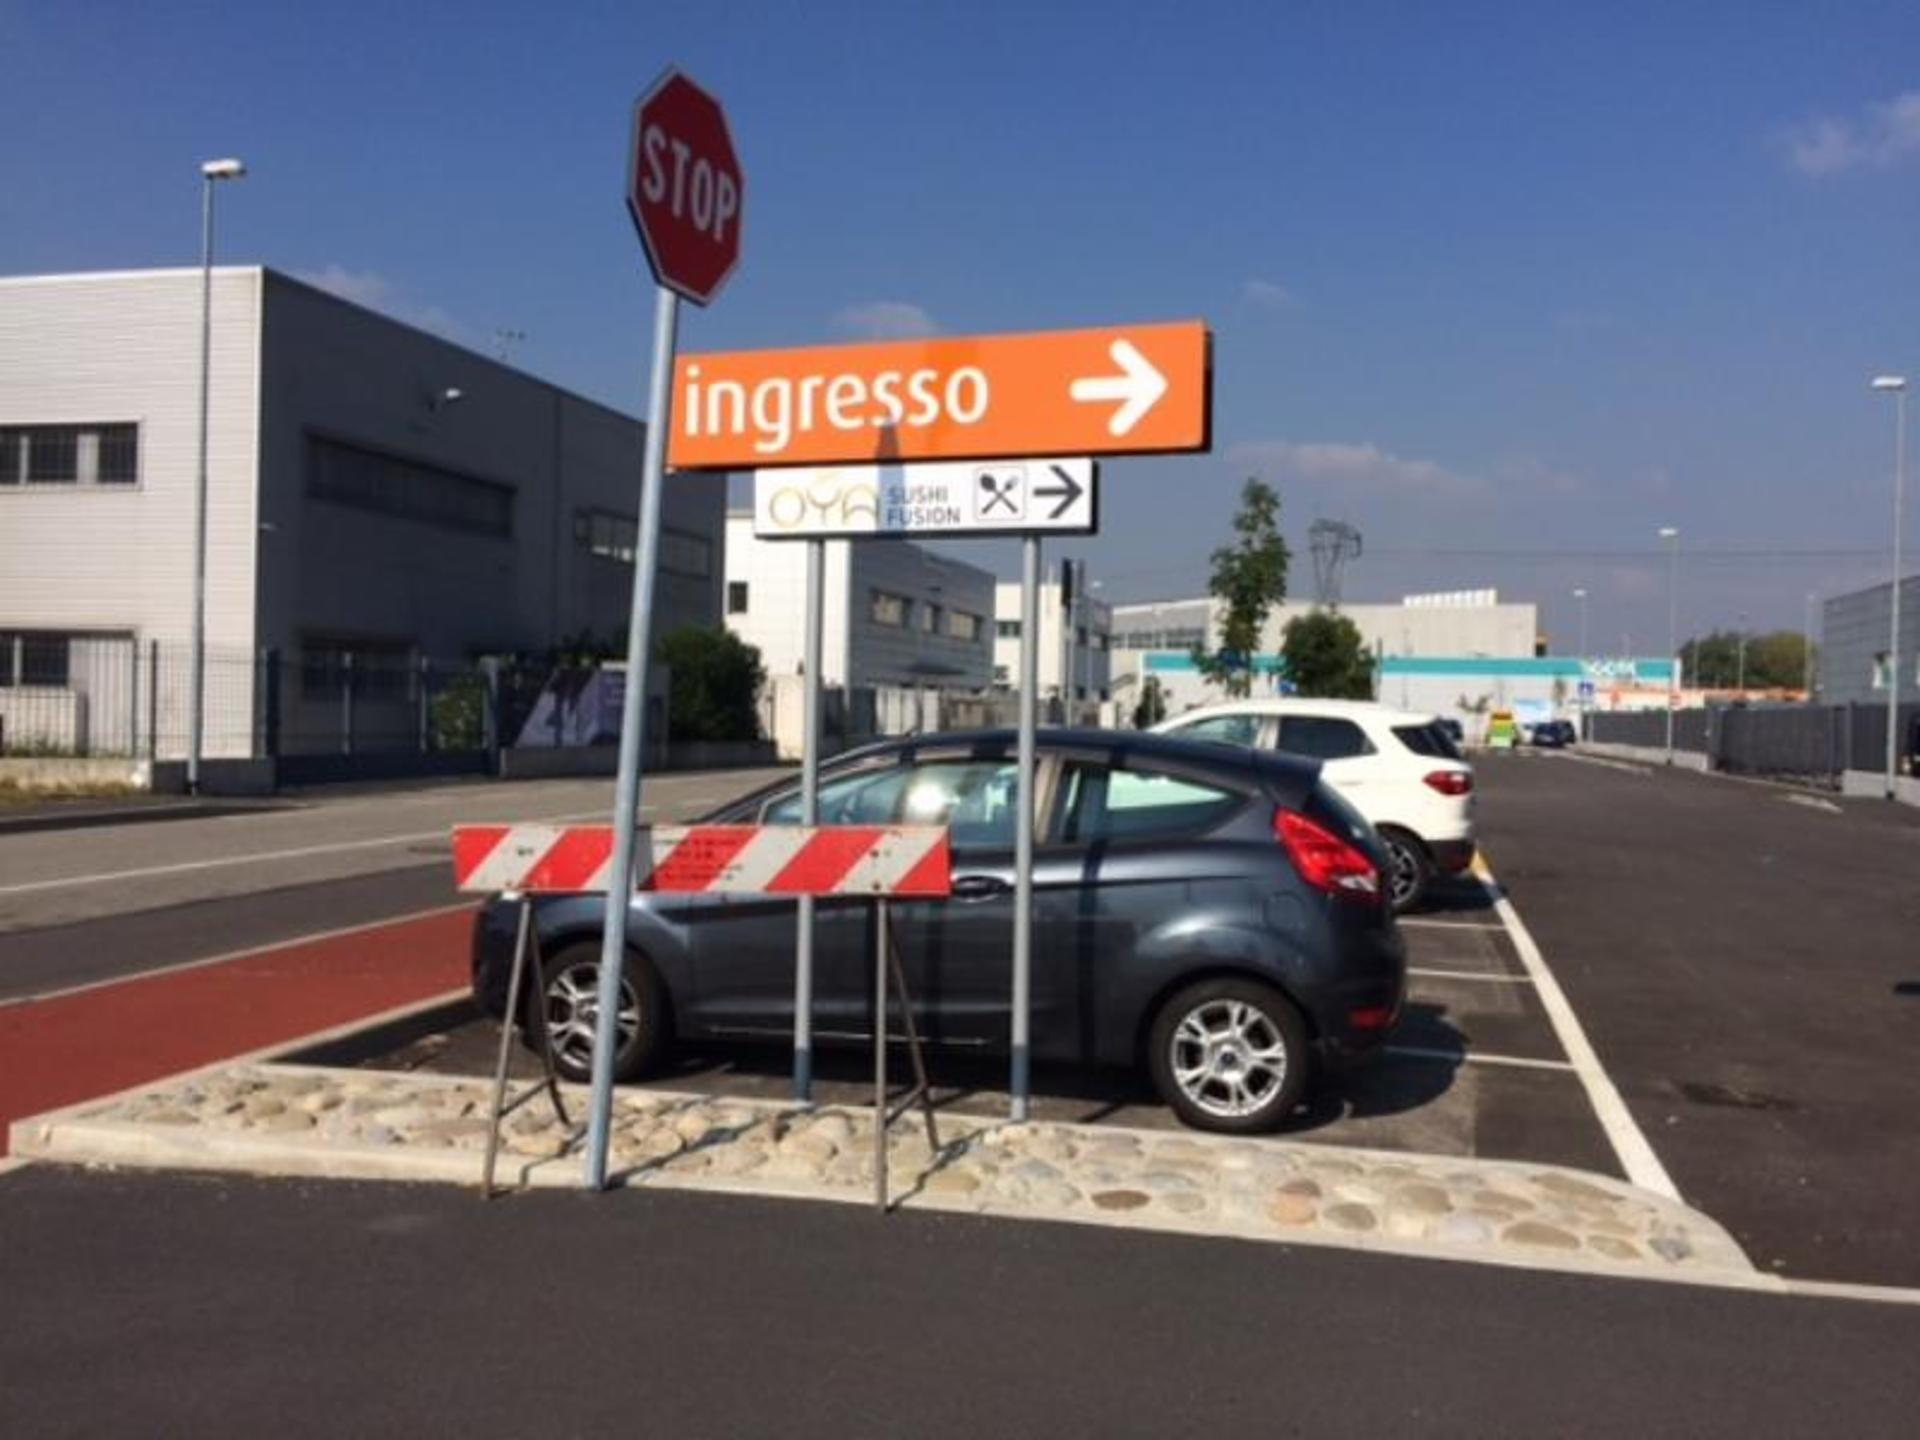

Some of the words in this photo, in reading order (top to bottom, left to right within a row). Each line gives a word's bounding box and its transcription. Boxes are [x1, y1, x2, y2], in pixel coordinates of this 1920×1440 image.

[642, 124, 736, 241] STOP
[686, 364, 988, 453] ingresso
[769, 484, 880, 528] OYA
[887, 485, 949, 505] SUSHI
[887, 506, 961, 527] FUSION
